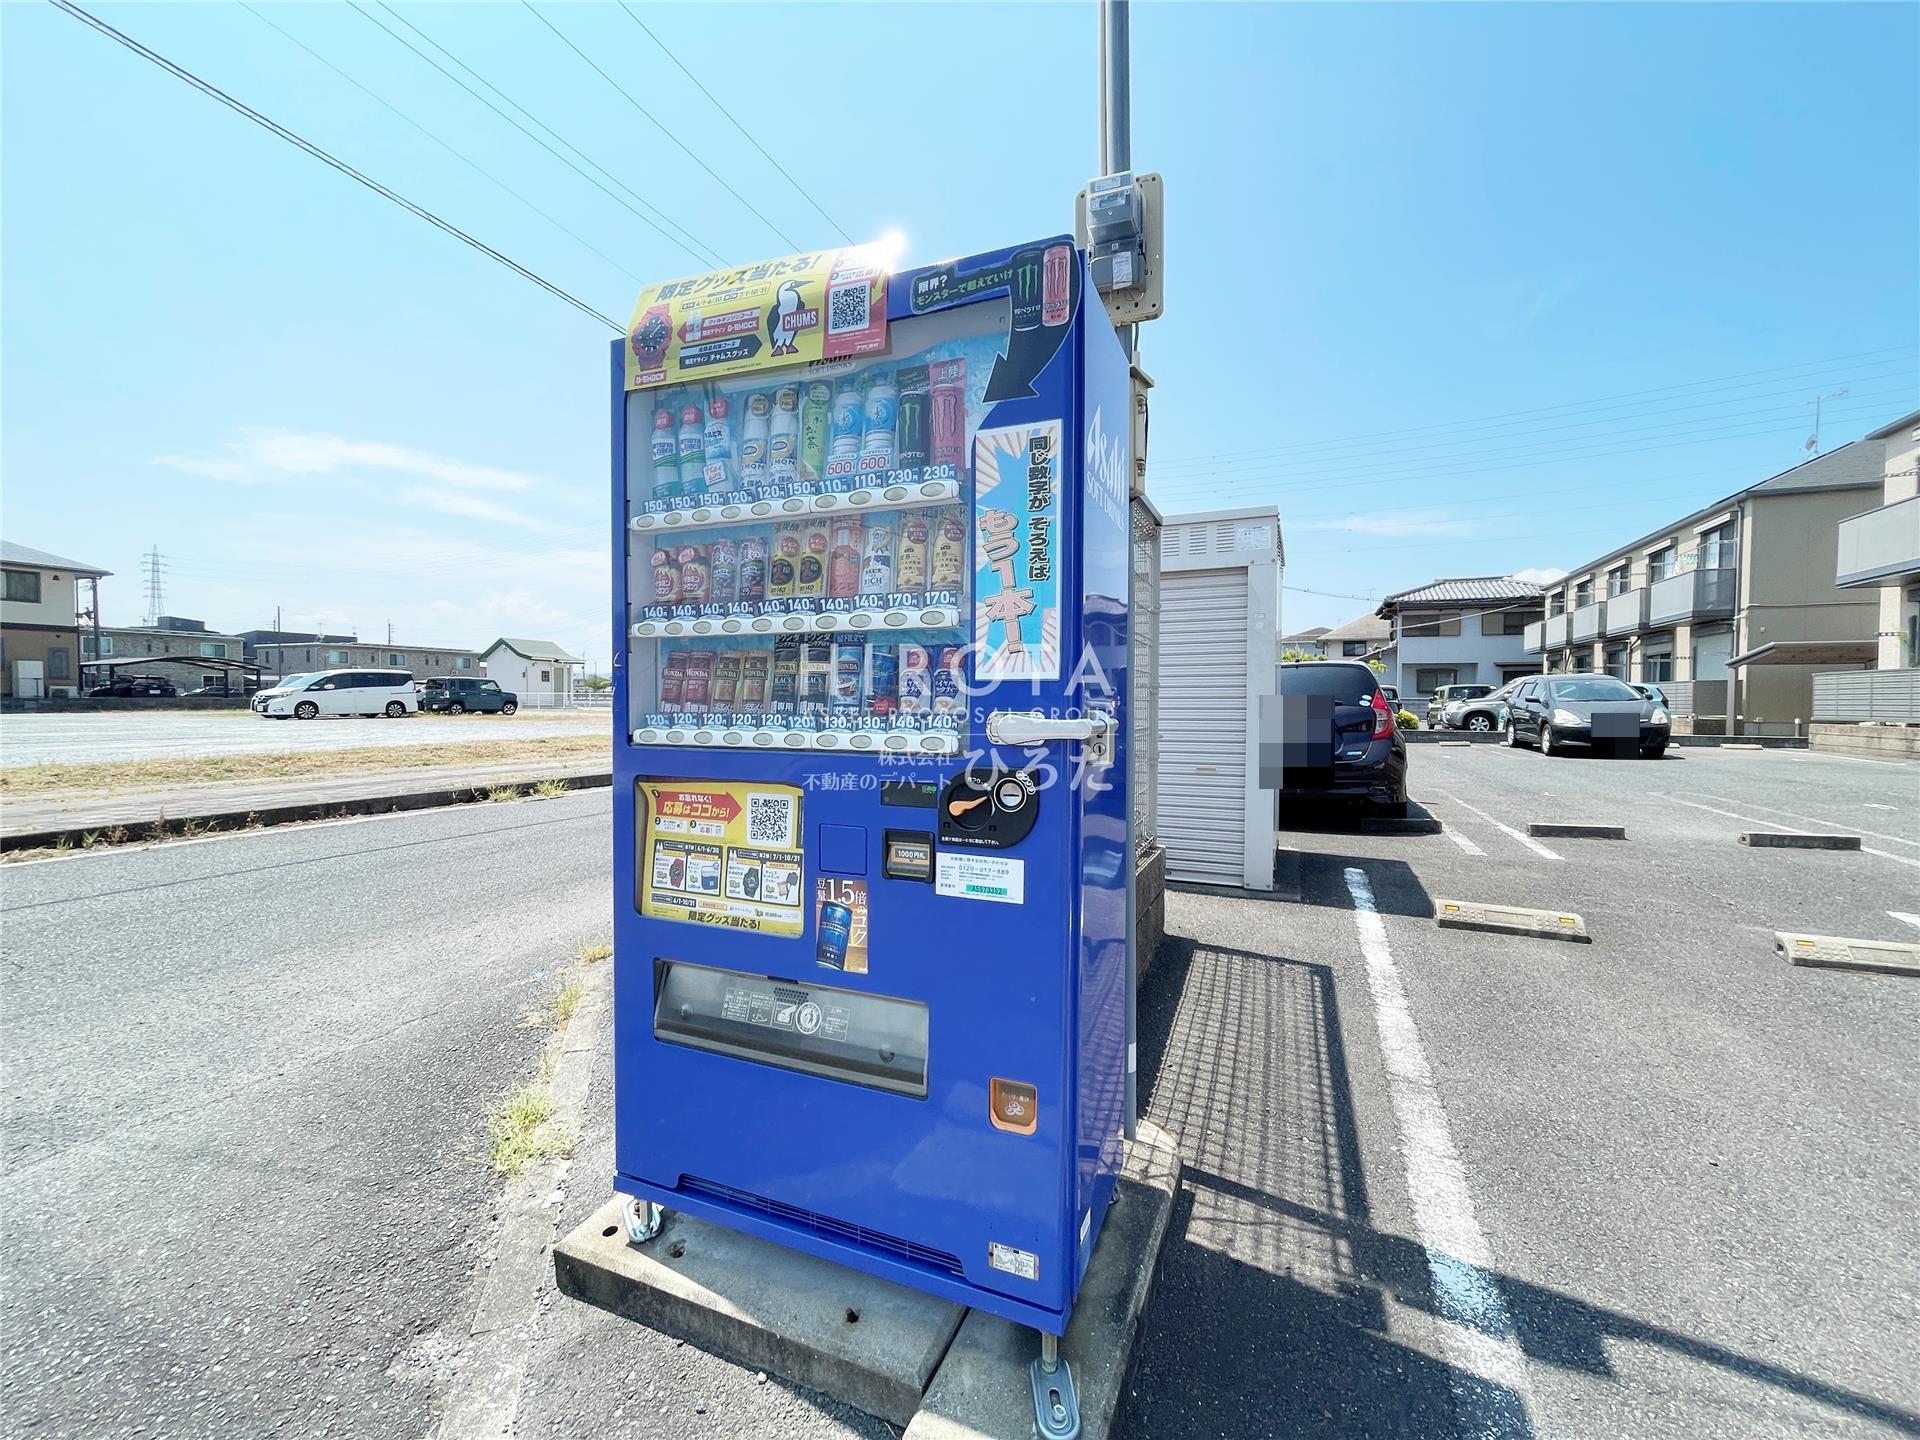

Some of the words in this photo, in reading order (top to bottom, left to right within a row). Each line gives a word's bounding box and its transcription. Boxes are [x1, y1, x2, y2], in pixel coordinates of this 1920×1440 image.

[916, 269, 1013, 305] モンスターで超えていけ
[918, 275, 948, 294] 限界?
[727, 320, 758, 332] G-SHOCK
[785, 311, 818, 330] CHUMS
[635, 372, 665, 384] G-SHOCK
[937, 365, 960, 380] 上陸
[860, 456, 887, 470] 600
[1087, 403, 1125, 507] Asahi
[827, 461, 853, 475] 600
[1029, 435, 1051, 513] 同じ数字が
[1029, 517, 1051, 581] そろえば
[686, 668, 708, 678] WONDA
[663, 801, 730, 818] 応募はココから!
[773, 853, 800, 862] 7/1-10/31
[897, 849, 926, 859] 1000円札
[827, 878, 855, 905] 1.5
[687, 911, 761, 931] 限定グッズ当たる!
